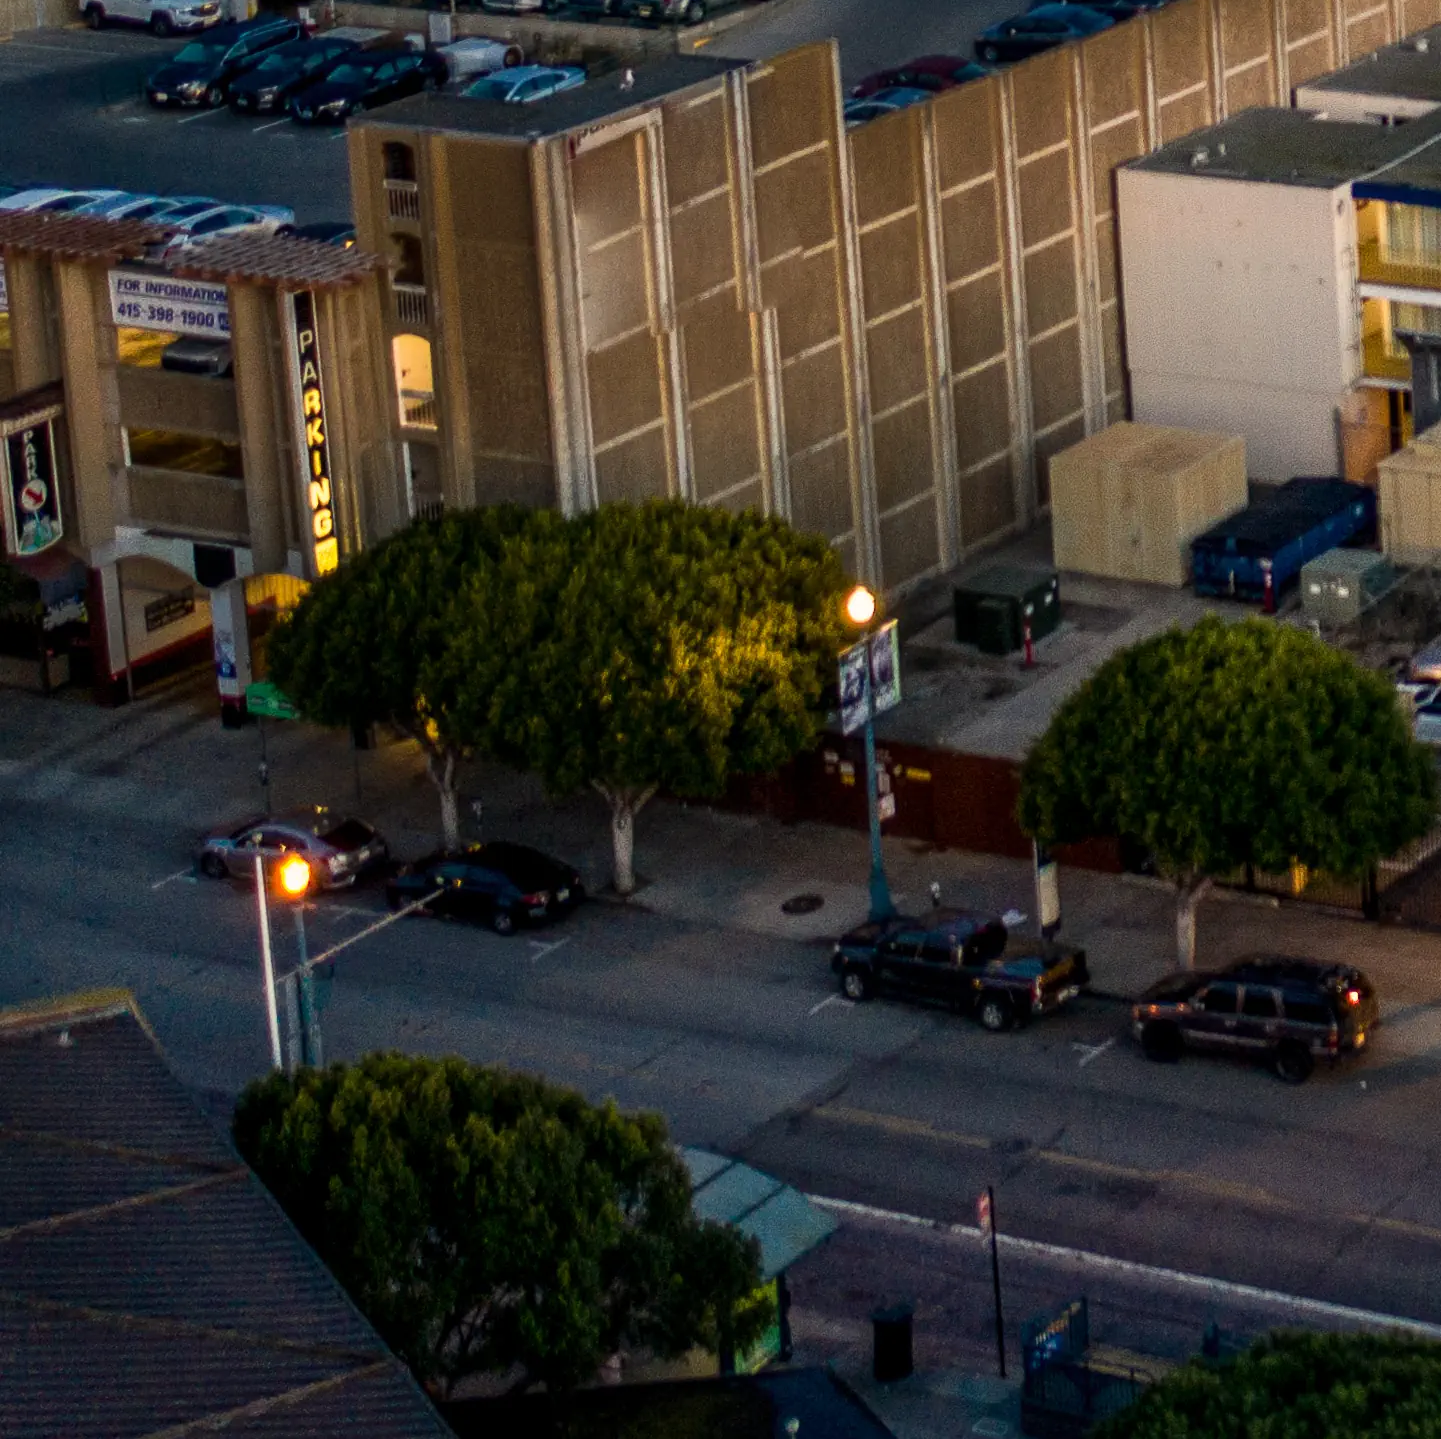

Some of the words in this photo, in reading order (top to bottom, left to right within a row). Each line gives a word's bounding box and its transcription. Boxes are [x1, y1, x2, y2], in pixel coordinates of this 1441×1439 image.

[117, 279, 140, 291] FOR
[145, 281, 227, 302] INFORMATION
[117, 302, 215, 328] 415-398-1900
[299, 329, 333, 538] PARKING
